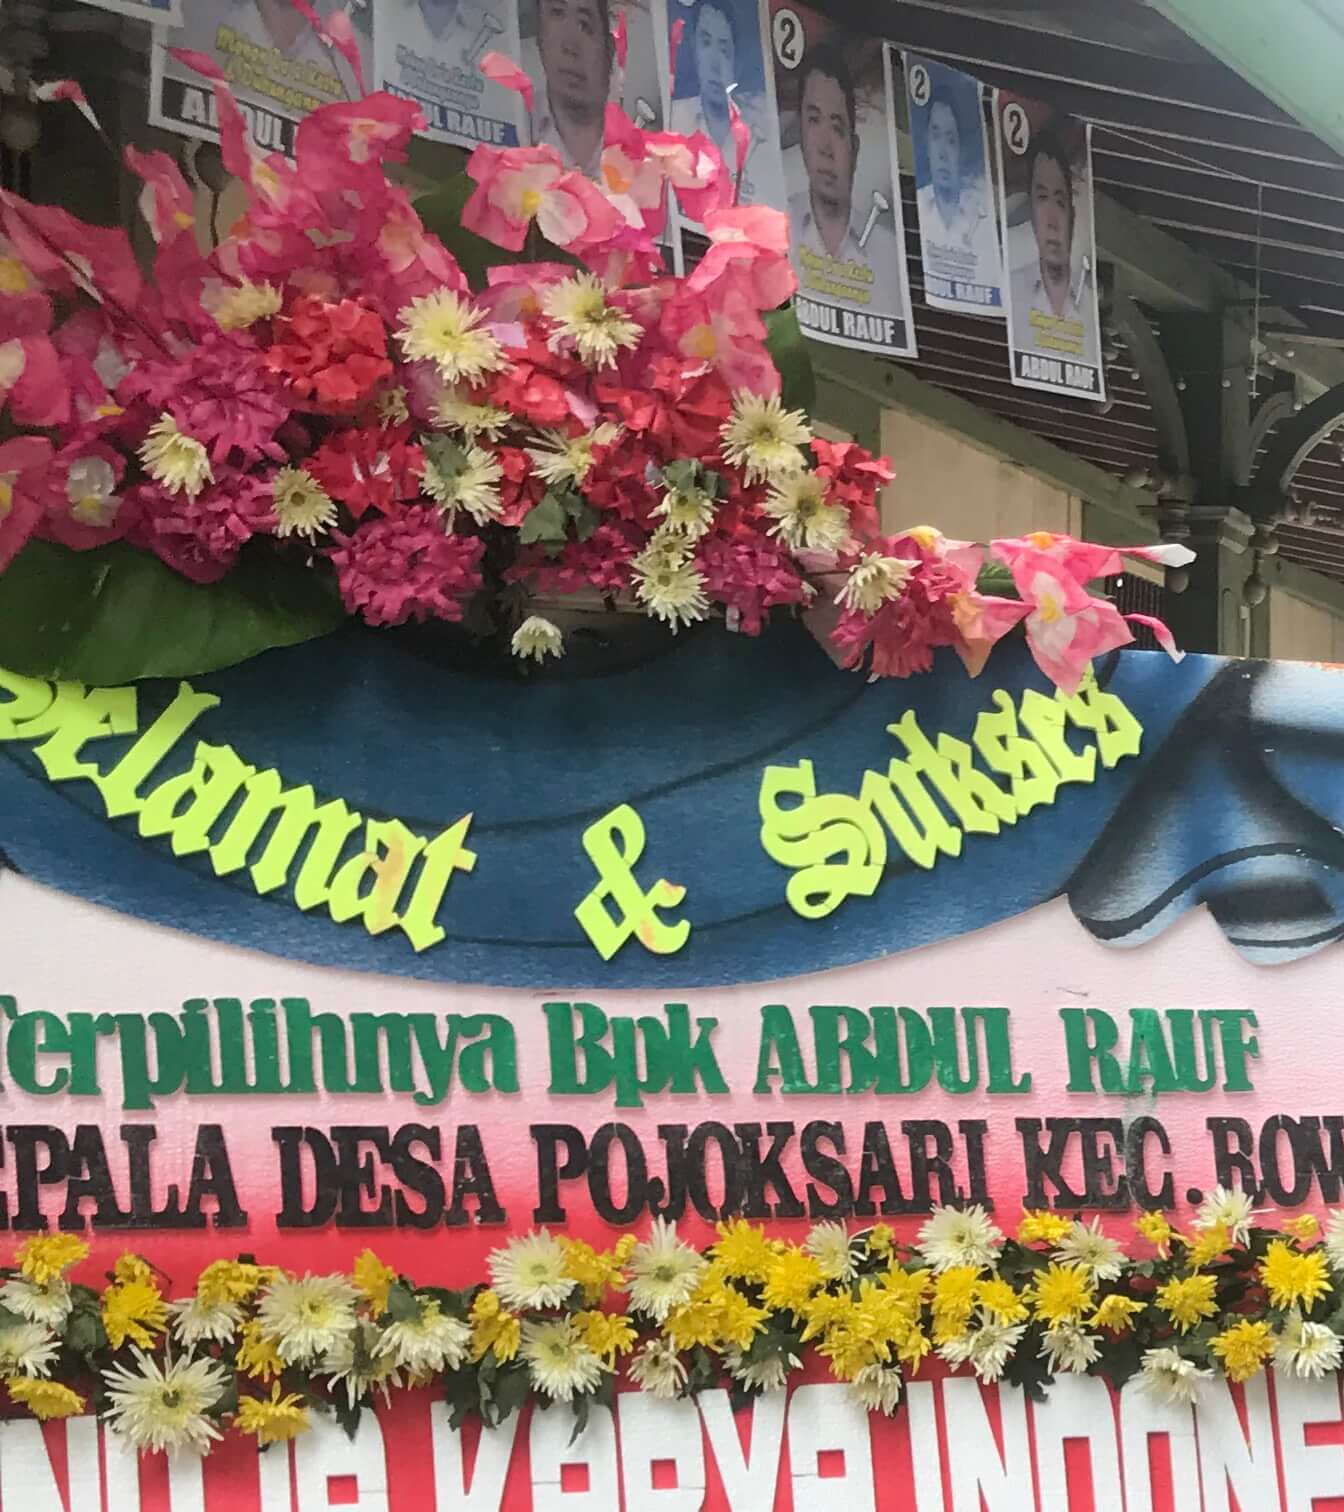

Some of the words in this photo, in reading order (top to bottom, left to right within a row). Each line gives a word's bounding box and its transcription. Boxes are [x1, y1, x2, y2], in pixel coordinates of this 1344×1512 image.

[780, 17, 796, 61] 2
[915, 69, 926, 99] 2
[1009, 110, 1023, 149] 2
[842, 311, 895, 344] RAUF
[574, 804, 691, 960] &
[759, 664, 1144, 919] Sukses
[0, 994, 520, 1109] erpilihnya
[543, 1002, 729, 1108] Bpk
[752, 1004, 1032, 1095] ABDUL
[1059, 1007, 1260, 1095] RAUF
[0, 1124, 248, 1230] PALA
[273, 1121, 506, 1231] DESA
[530, 1118, 995, 1227] POJOKSARI
